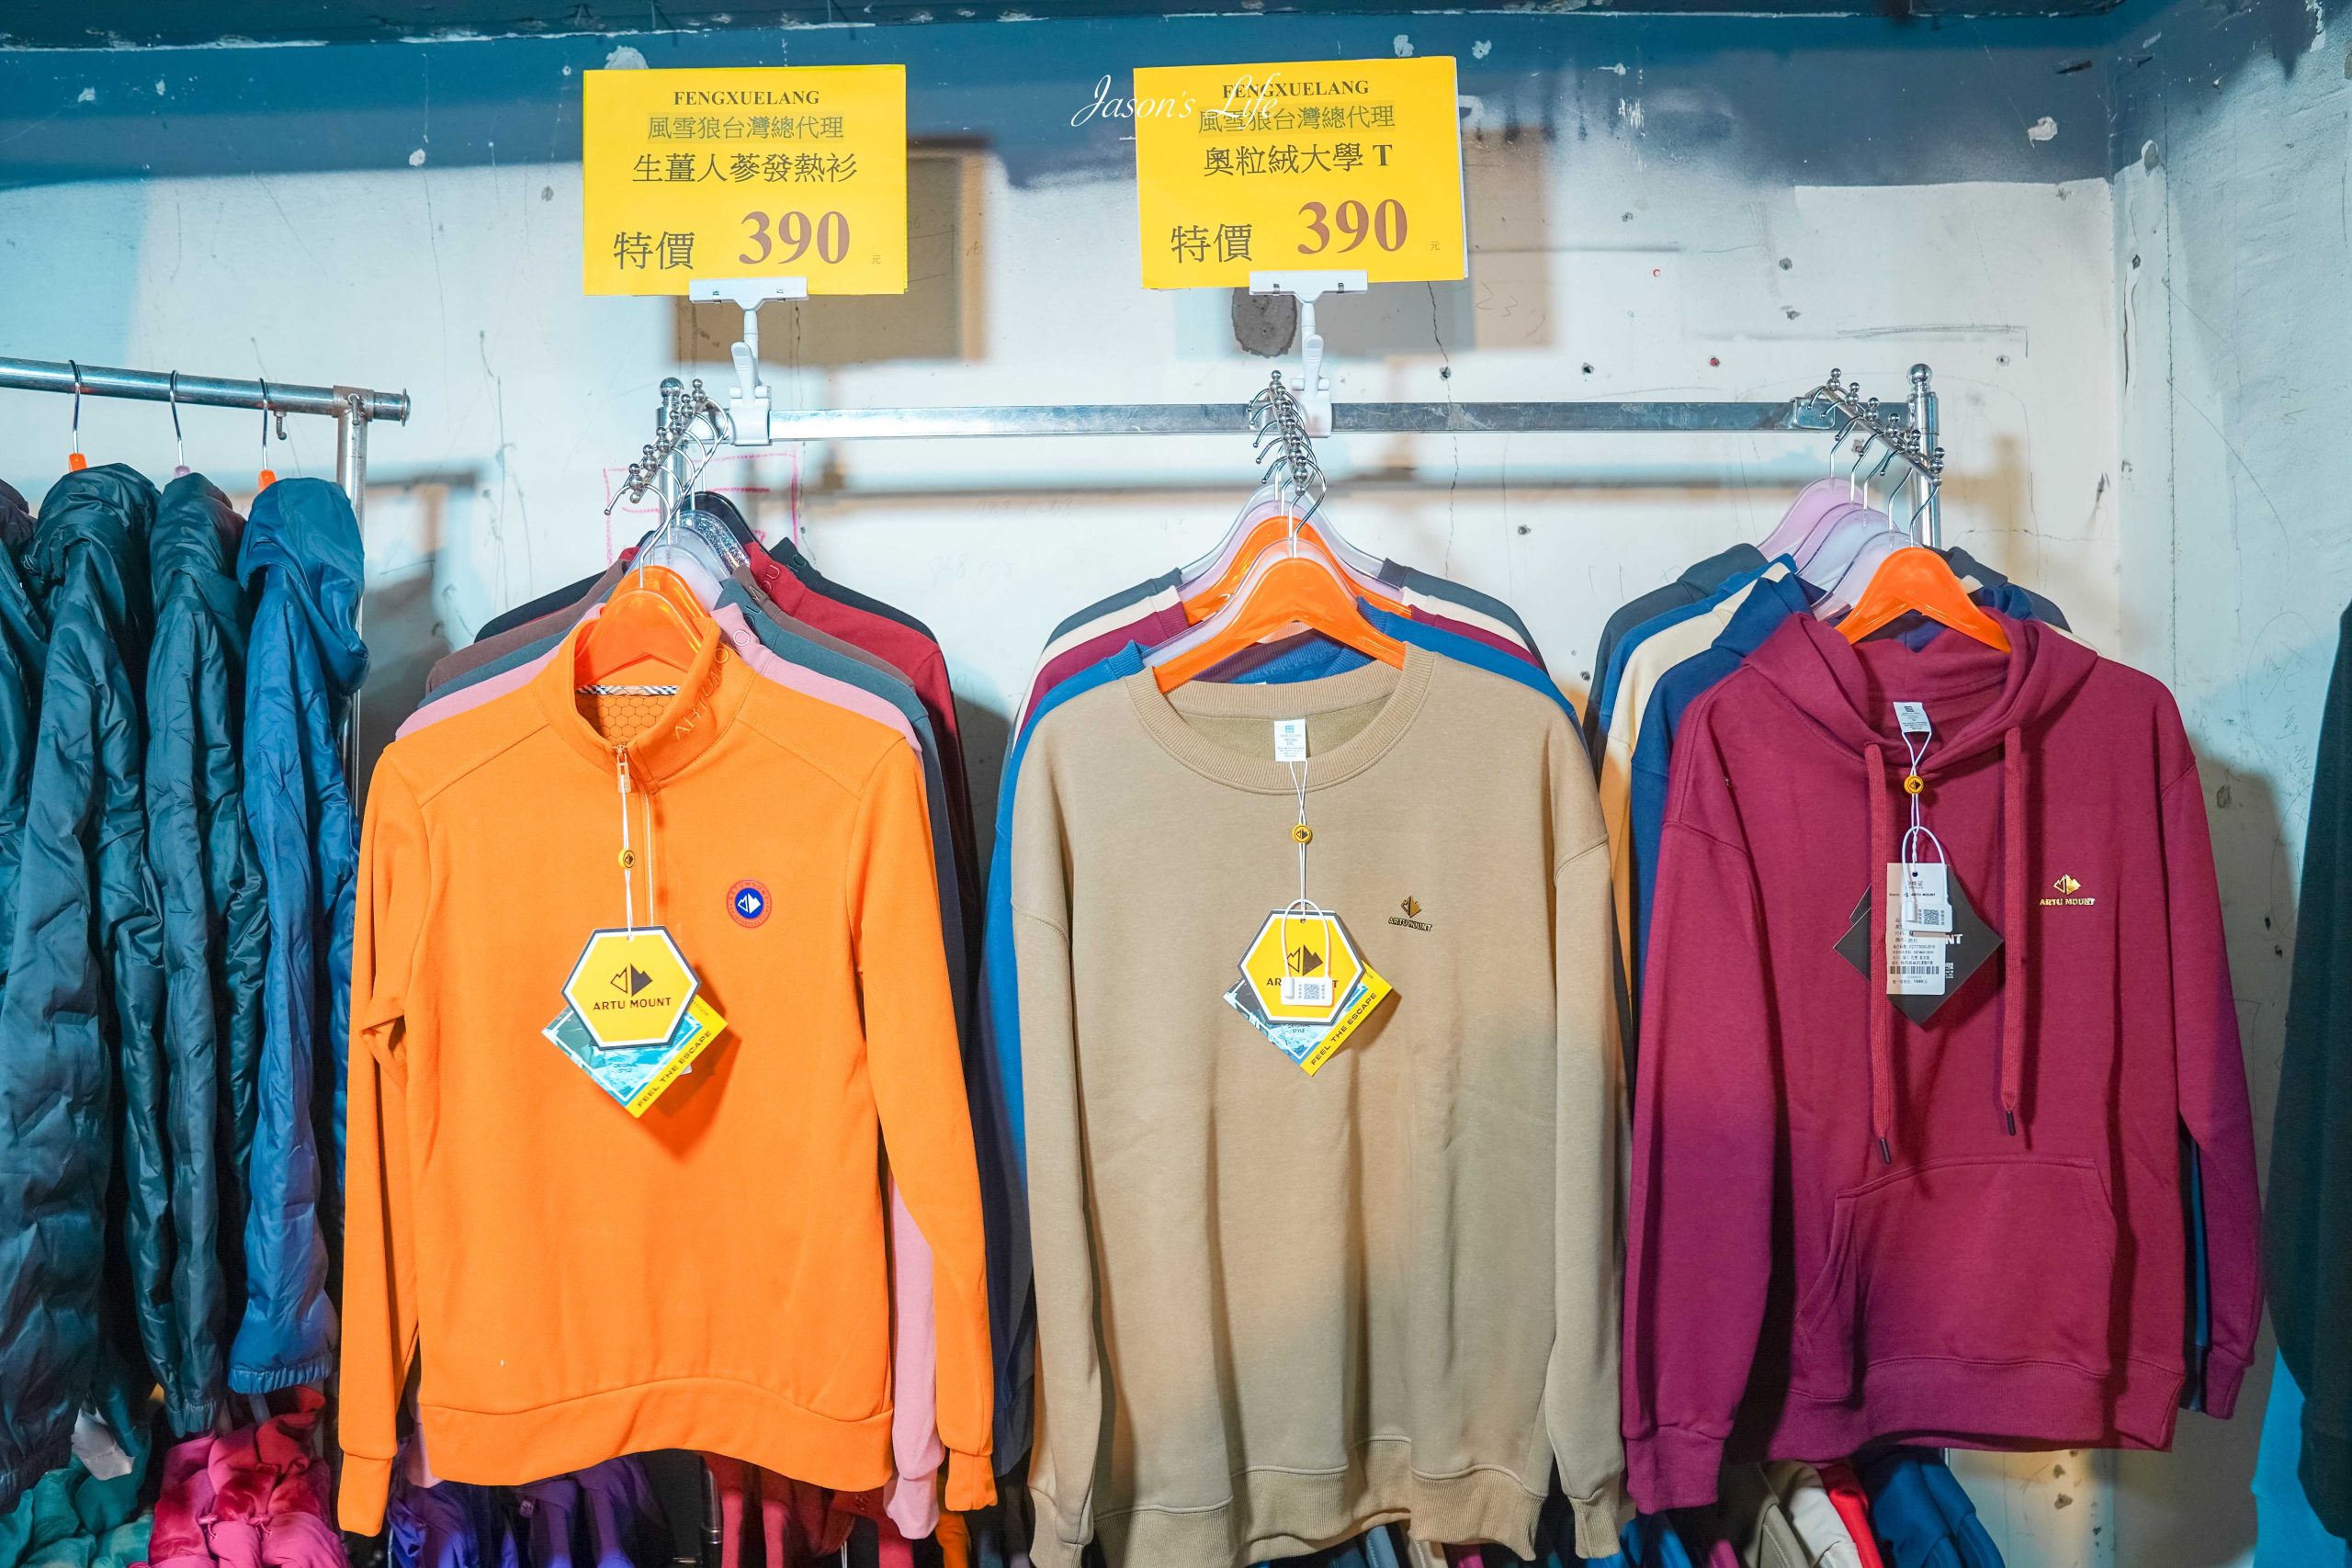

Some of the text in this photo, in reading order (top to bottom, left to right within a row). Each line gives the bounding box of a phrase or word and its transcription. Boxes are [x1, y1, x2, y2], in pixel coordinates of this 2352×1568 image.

[673, 90, 820, 106] FENGXUELANG
[1223, 80, 1369, 99] FENGXUELANG
[647, 116, 844, 140] 風雪狼台灣總代理
[632, 152, 858, 184] 生薑人蔘發熱衫
[1203, 143, 1393, 177] 奧粒絨大學 T
[613, 210, 882, 271] 特價 390 元
[1170, 198, 1441, 265] 特價 390 元
[2039, 897, 2096, 907] ARTU MOUNT
[1266, 977, 1282, 987] AR
[594, 997, 672, 1010] ARTU MOUNT
[1310, 992, 1377, 1066] FEEL THE ESCAPE
[637, 1087, 660, 1108] FEEL
[659, 1065, 679, 1082] THE
[678, 1030, 712, 1065] ESCAPE
